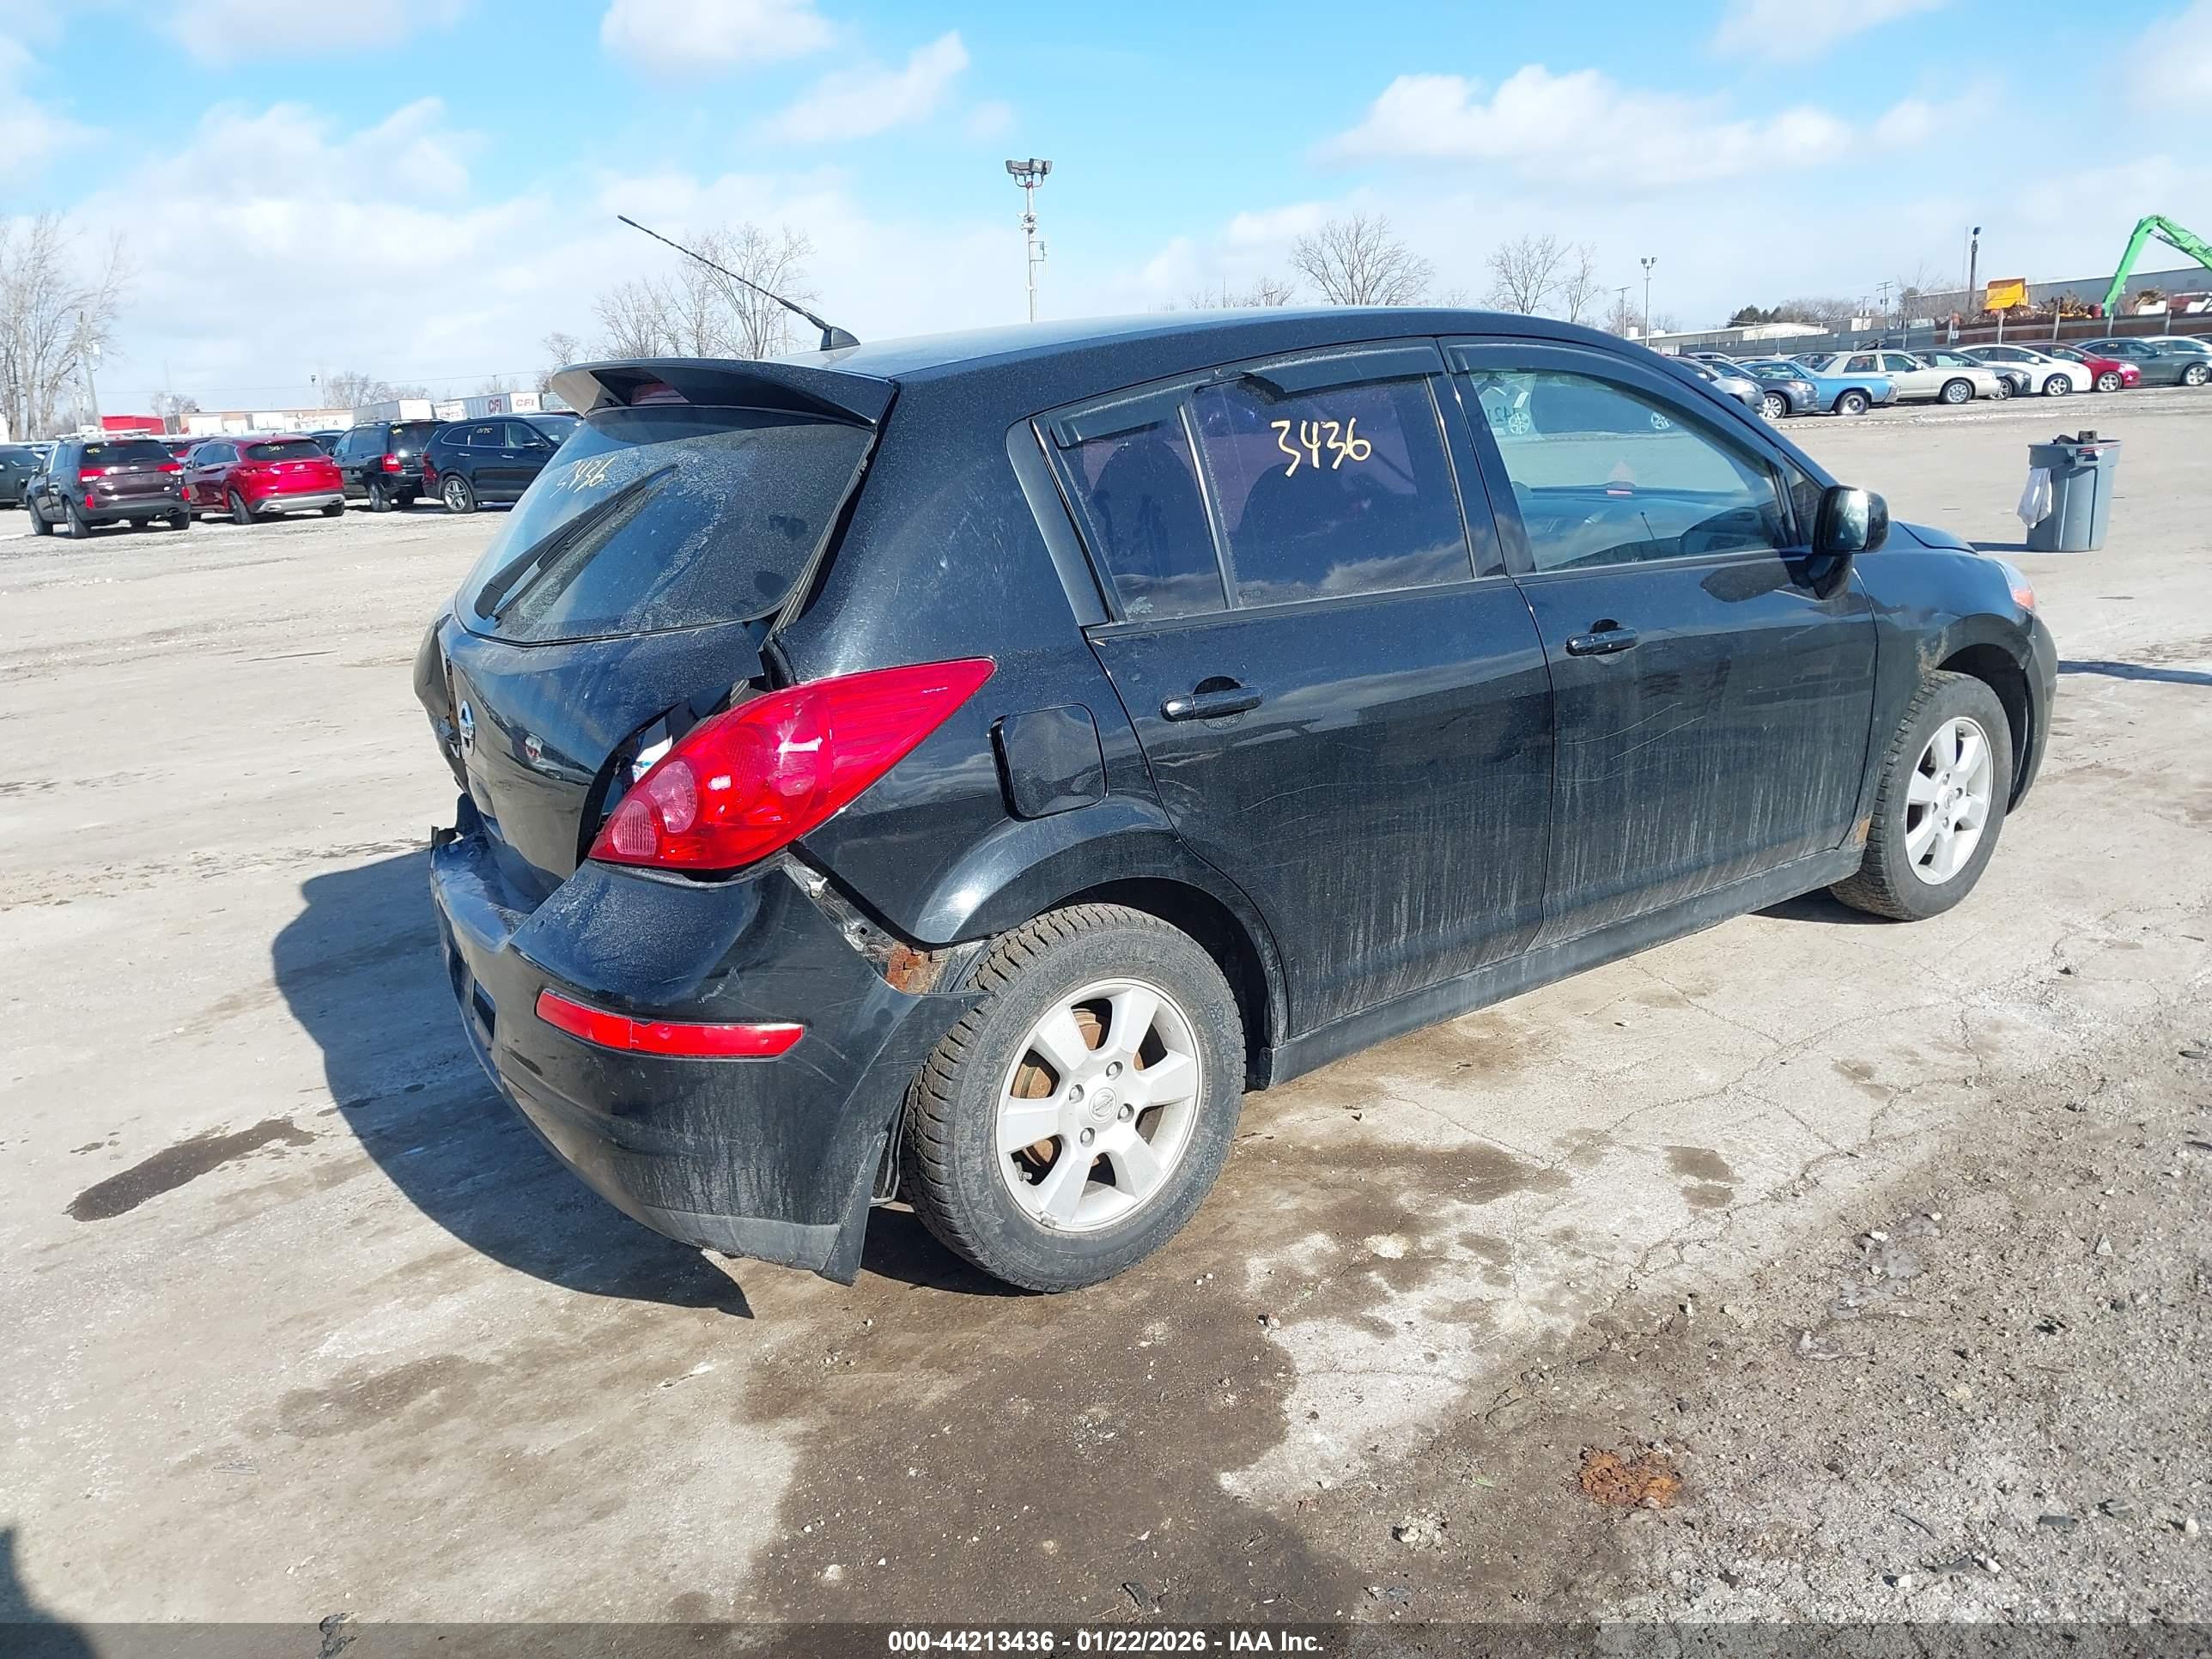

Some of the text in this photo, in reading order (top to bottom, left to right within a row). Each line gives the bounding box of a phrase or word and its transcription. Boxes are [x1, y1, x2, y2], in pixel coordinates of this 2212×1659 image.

[488, 398, 502, 413] CFI
[515, 398, 534, 407] CFI
[1271, 418, 1371, 477] 3436
